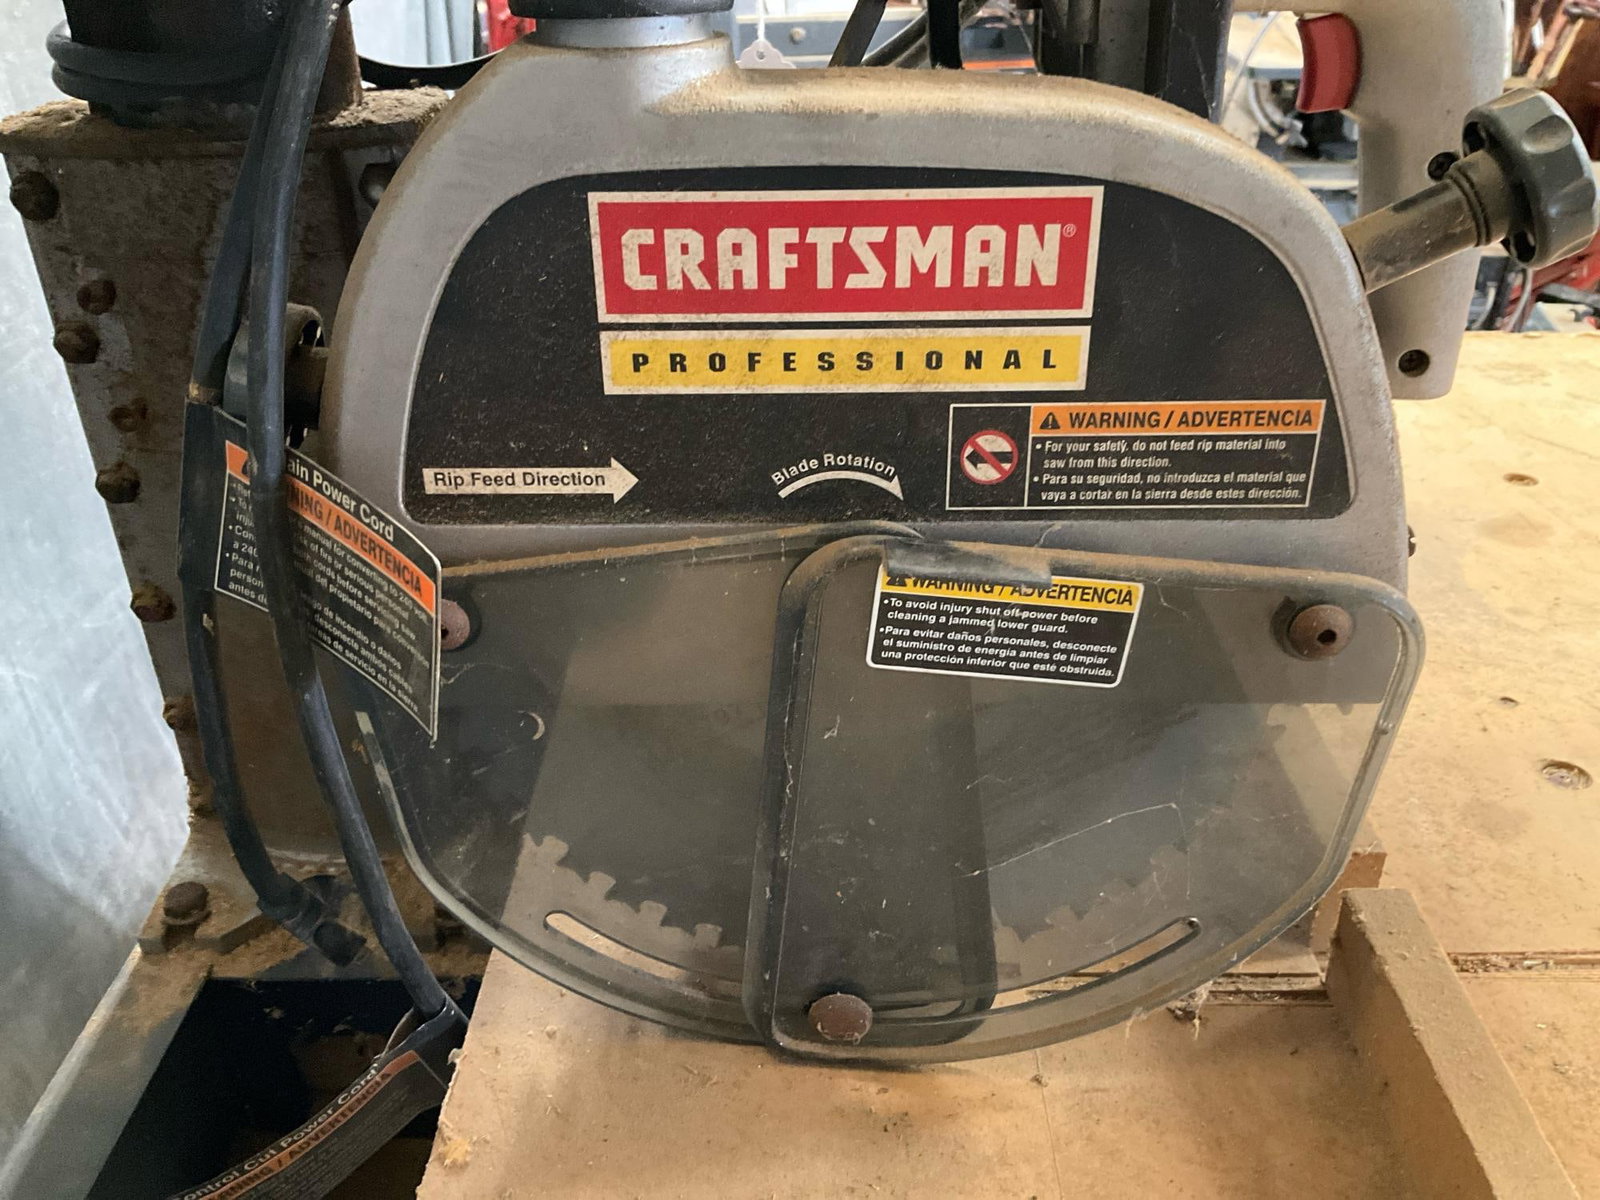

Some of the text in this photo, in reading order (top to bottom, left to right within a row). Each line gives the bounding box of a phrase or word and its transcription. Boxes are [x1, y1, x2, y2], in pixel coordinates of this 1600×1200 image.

[621, 224, 1061, 290] CRAFTSMAN
[632, 349, 1057, 373] PROFESSIONAL
[1069, 410, 1160, 428] WARNING
[1177, 409, 1313, 428] ADVERTENCIA
[1045, 440, 1062, 452] For
[1066, 442, 1090, 454] your
[1132, 440, 1147, 452] do
[1149, 440, 1167, 452] not
[1169, 440, 1194, 451] feed
[1197, 439, 1212, 453] rip
[1215, 438, 1263, 451] material
[1264, 438, 1286, 450] into
[771, 453, 896, 486] Blade Rotation
[1043, 455, 1172, 469] saw from this direction.
[434, 471, 606, 490] Rip Feed Direction
[1042, 471, 1307, 486] Para su seguridad, no introduzca el material que
[287, 459, 394, 542] ain Power Cord
[1041, 486, 1302, 502] vaya a cortar en la sierra desde estes dirección.
[233, 540, 239, 550] a
[304, 525, 333, 554] manual
[333, 543, 346, 559] for
[309, 541, 319, 556] of
[333, 560, 343, 571] or
[344, 565, 375, 594] serious
[334, 515, 423, 599] ADVERTENCIA
[229, 567, 264, 589] person
[313, 558, 336, 580] cords
[337, 573, 363, 599] before
[231, 551, 254, 570] Para
[323, 605, 335, 620] de
[334, 612, 370, 645] incendio
[329, 582, 373, 620] propietario
[890, 597, 1098, 625] To avoid injury shut off power before
[228, 580, 257, 599] antes
[332, 640, 344, 653] de
[344, 648, 376, 677] servicio
[887, 610, 1068, 634] cleaning a jammed lower guard.
[883, 638, 894, 647] el
[896, 640, 955, 652] suministro
[957, 643, 972, 653] de
[1019, 650, 1050, 660] antes
[1053, 652, 1067, 662] de
[1070, 653, 1109, 666] limpiar
[885, 625, 1118, 654] Para evitar daños personales, desconecte
[881, 650, 902, 659] una
[904, 652, 964, 665] protección
[966, 657, 1007, 668] inferior
[1009, 660, 1030, 671] que
[1033, 662, 1057, 673] esté
[173, 1063, 379, 1200] ontrol Cut Power Cord
